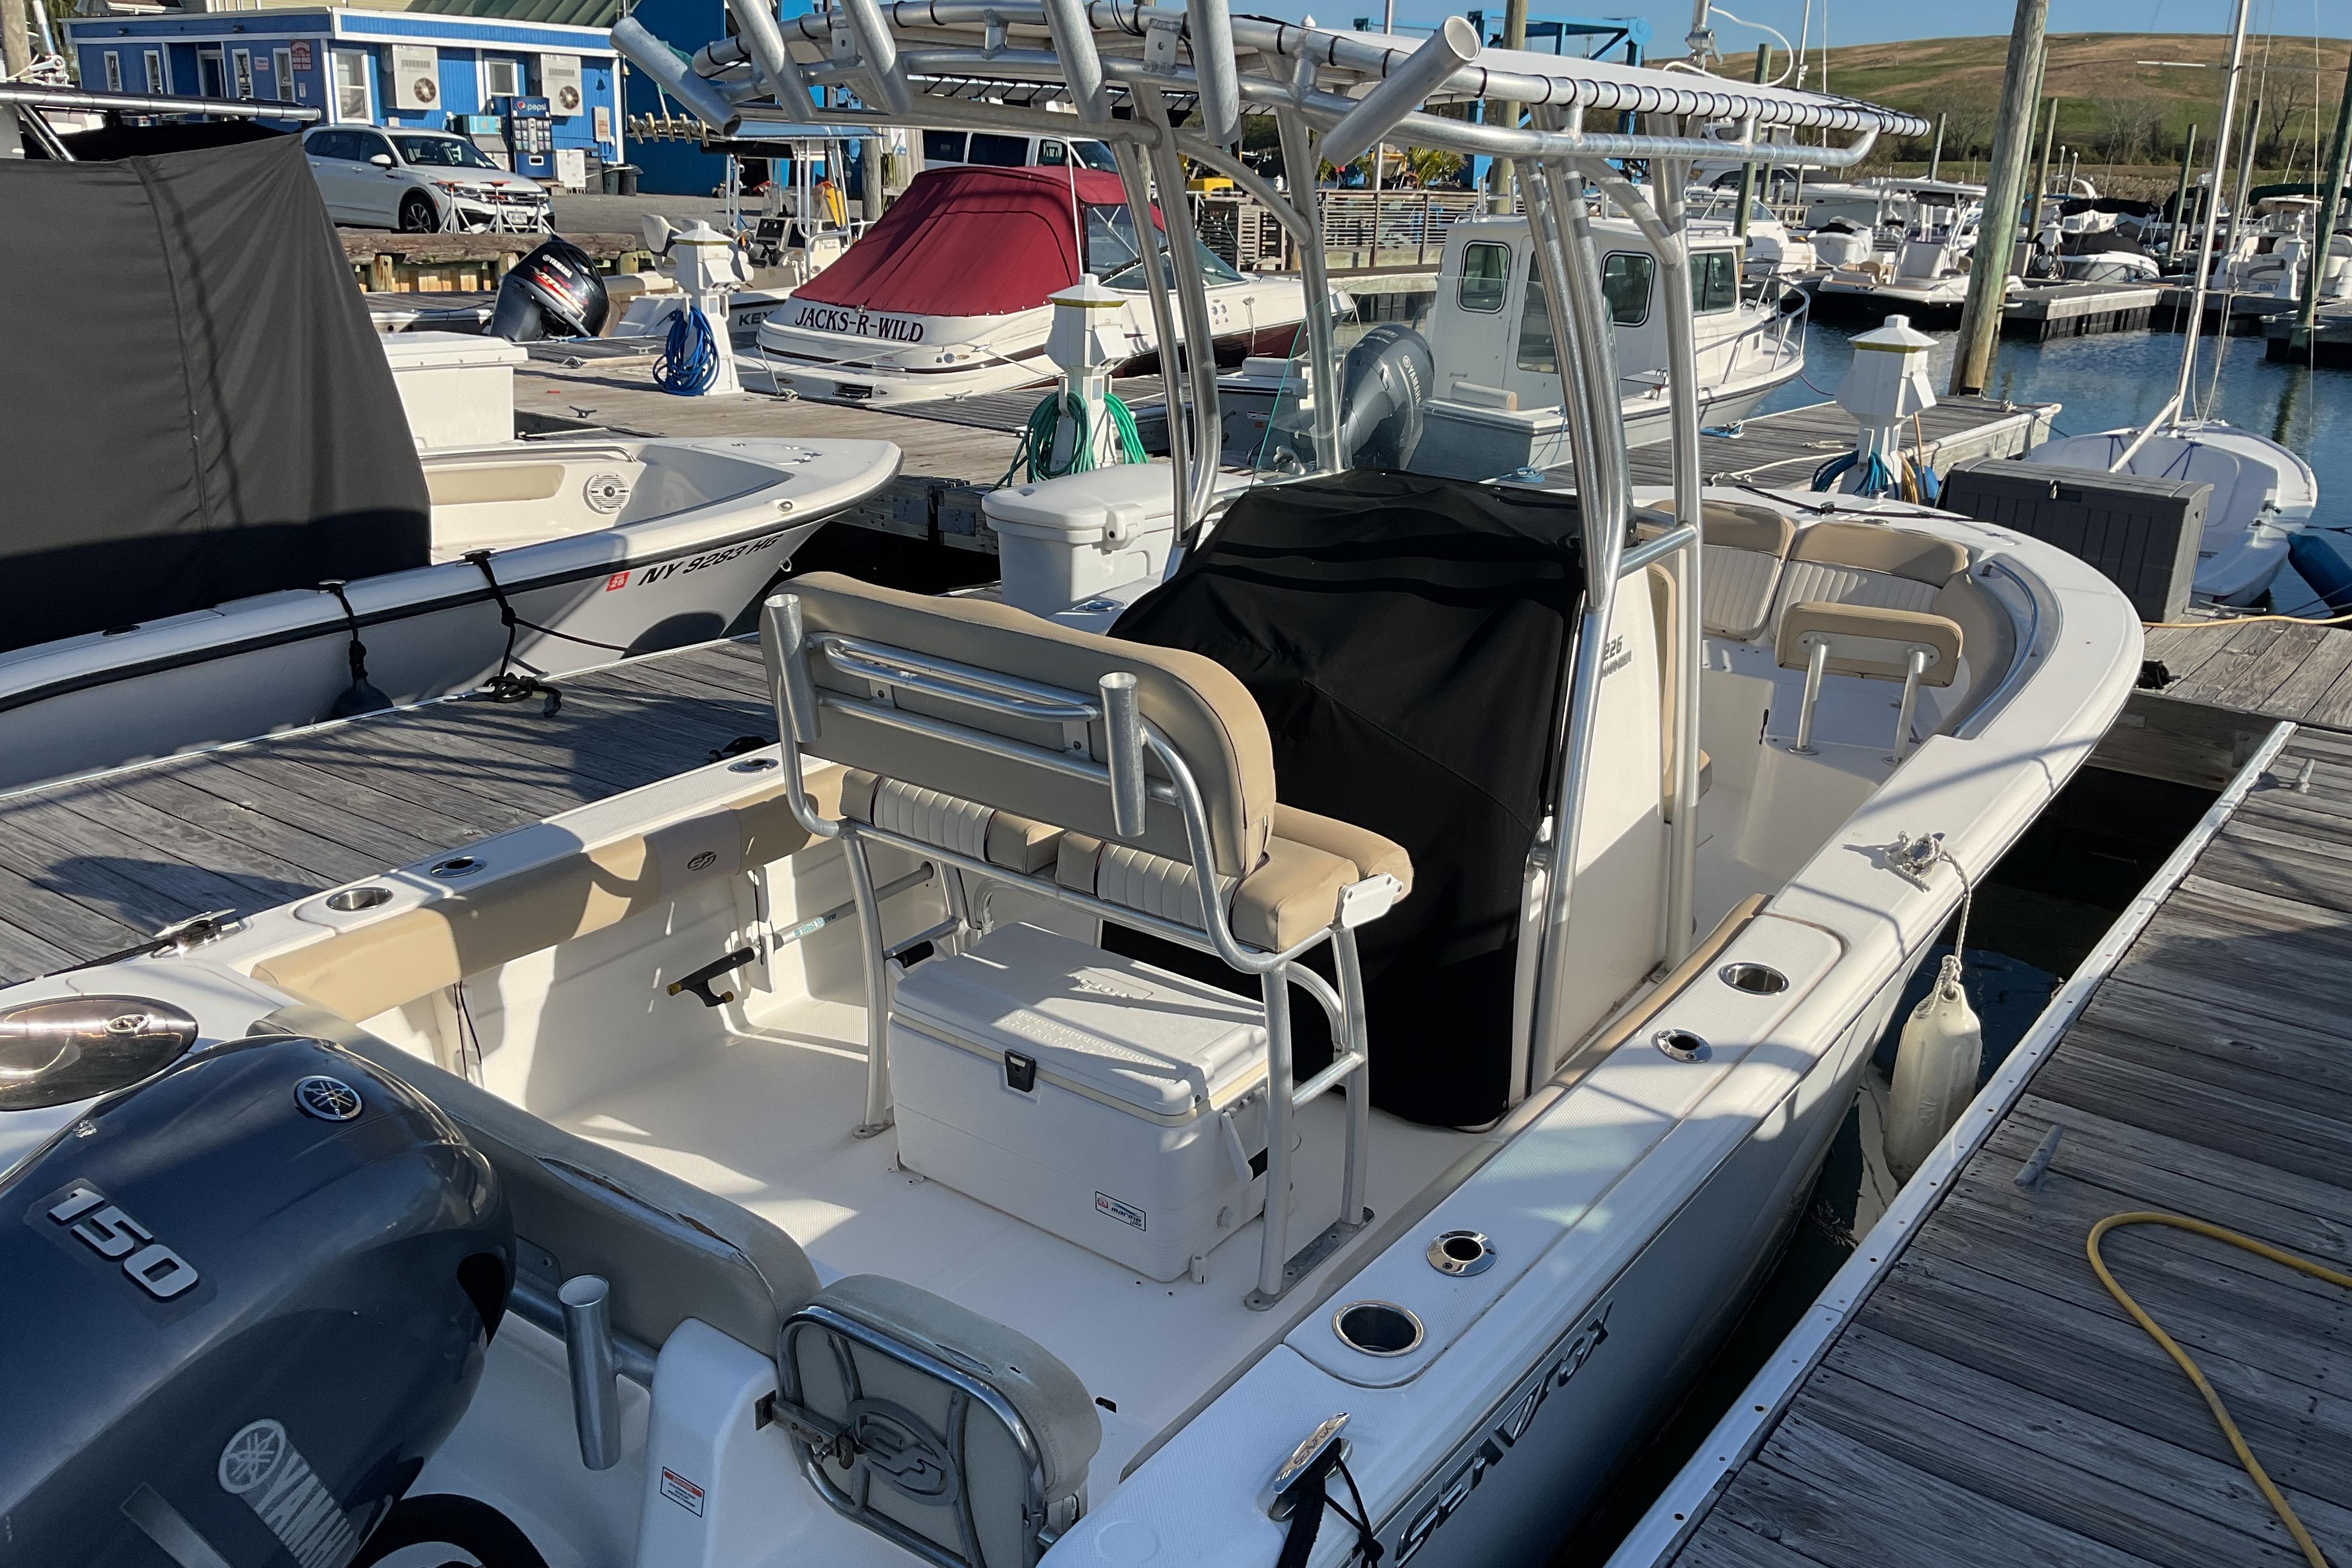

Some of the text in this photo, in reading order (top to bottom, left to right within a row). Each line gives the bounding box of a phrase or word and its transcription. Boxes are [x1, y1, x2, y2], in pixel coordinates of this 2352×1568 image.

[527, 103, 547, 112] pepsi
[549, 257, 572, 278] YAMAHA
[794, 307, 924, 342] JACKS-R-WILD
[637, 534, 784, 586] NY 9283 HG
[611, 578, 625, 587] 28
[800, 913, 836, 933] West Marine
[48, 1188, 198, 1298] 150
[254, 1450, 355, 1568] YAMAHA
